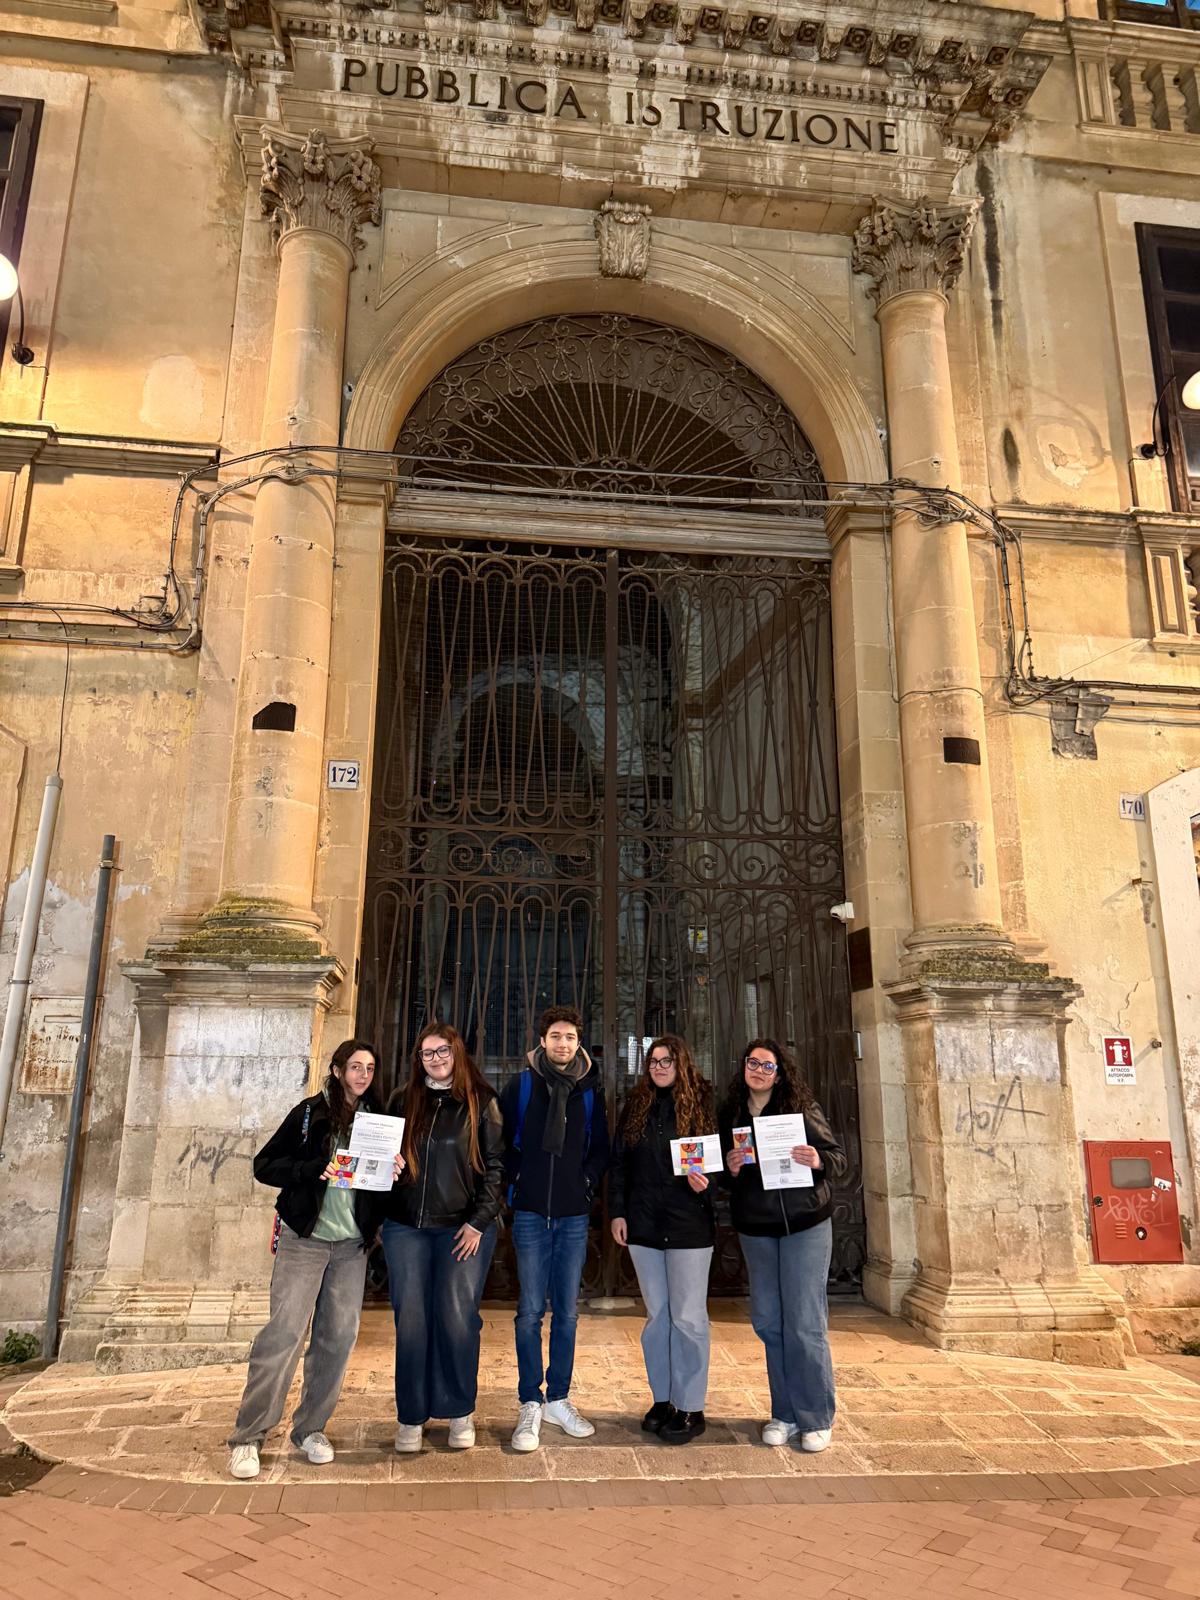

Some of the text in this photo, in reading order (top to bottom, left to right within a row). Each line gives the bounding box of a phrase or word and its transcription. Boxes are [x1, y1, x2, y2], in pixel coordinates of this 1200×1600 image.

[341, 58, 899, 153] PUBBLICA ISTRUZIONE
[331, 766, 357, 783] 172
[1121, 798, 1144, 815] 170
